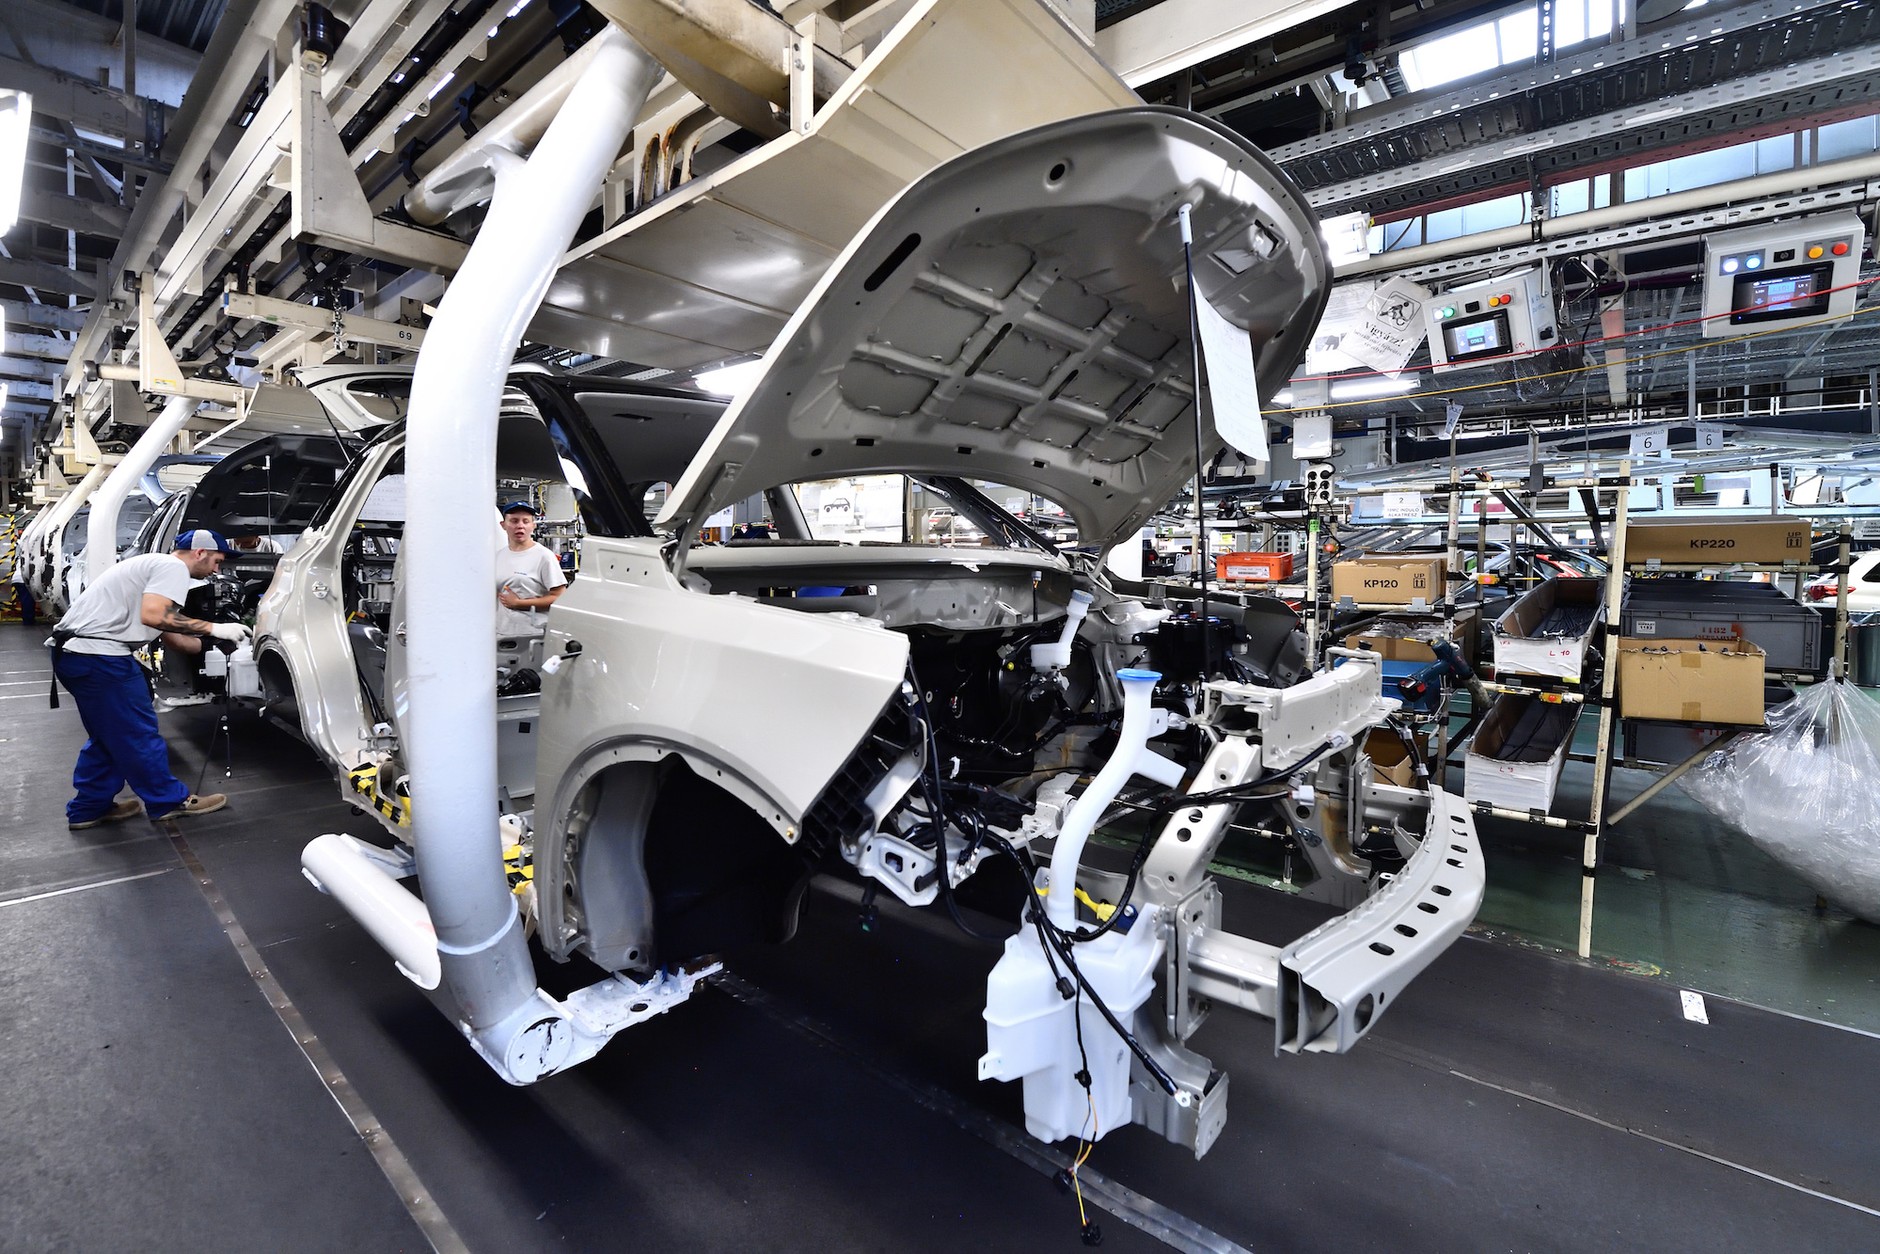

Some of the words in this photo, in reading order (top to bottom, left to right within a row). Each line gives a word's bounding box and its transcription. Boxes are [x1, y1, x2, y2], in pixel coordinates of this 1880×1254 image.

[399, 330, 412, 341] 69
[1365, 321, 1404, 347] Vigyázz!
[1644, 436, 1653, 449] 6
[1706, 434, 1713, 446] 6
[1690, 540, 1735, 548] KP220
[1364, 580, 1398, 588] KP120
